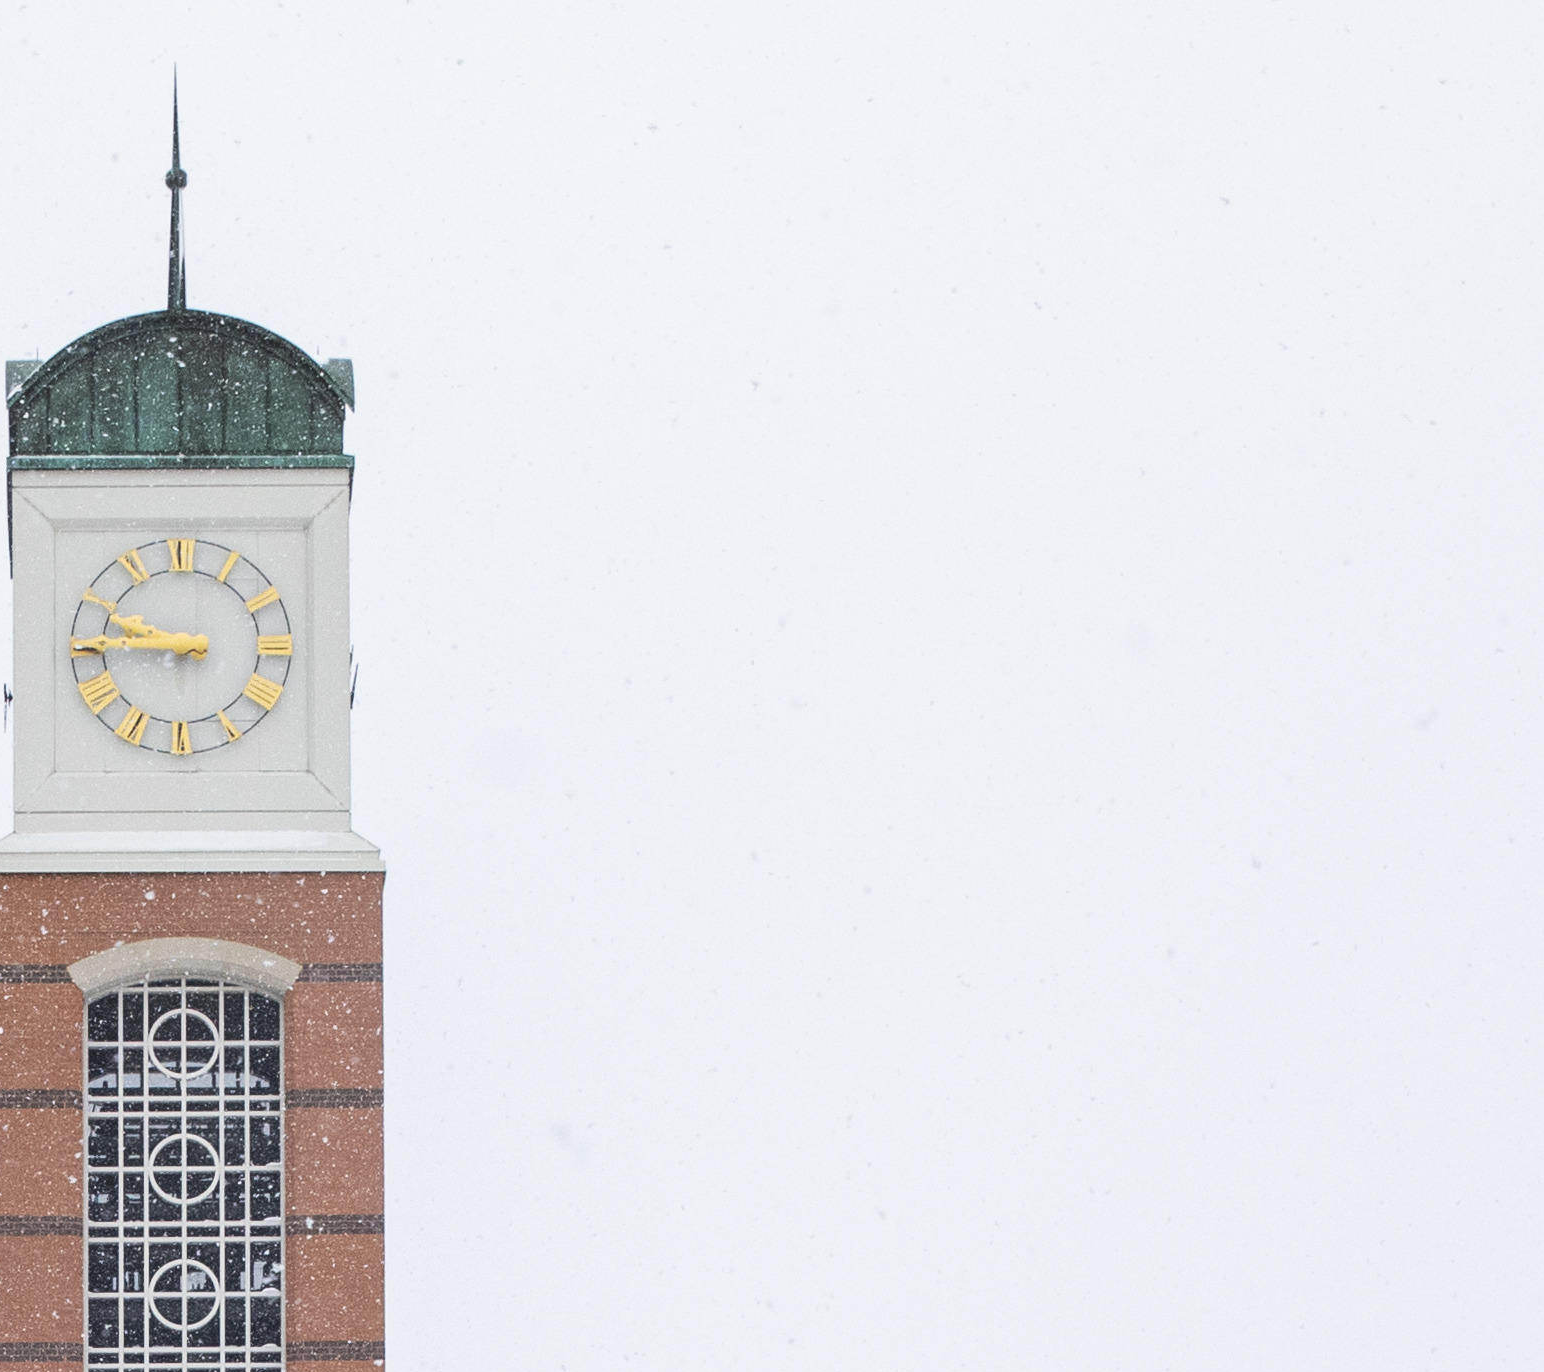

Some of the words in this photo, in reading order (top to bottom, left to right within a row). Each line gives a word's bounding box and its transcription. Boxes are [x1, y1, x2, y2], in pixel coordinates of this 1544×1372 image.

[168, 540, 195, 571] XII
[218, 552, 240, 582] I
[246, 586, 280, 613] II
[258, 635, 292, 655] III
[218, 711, 242, 742] V
